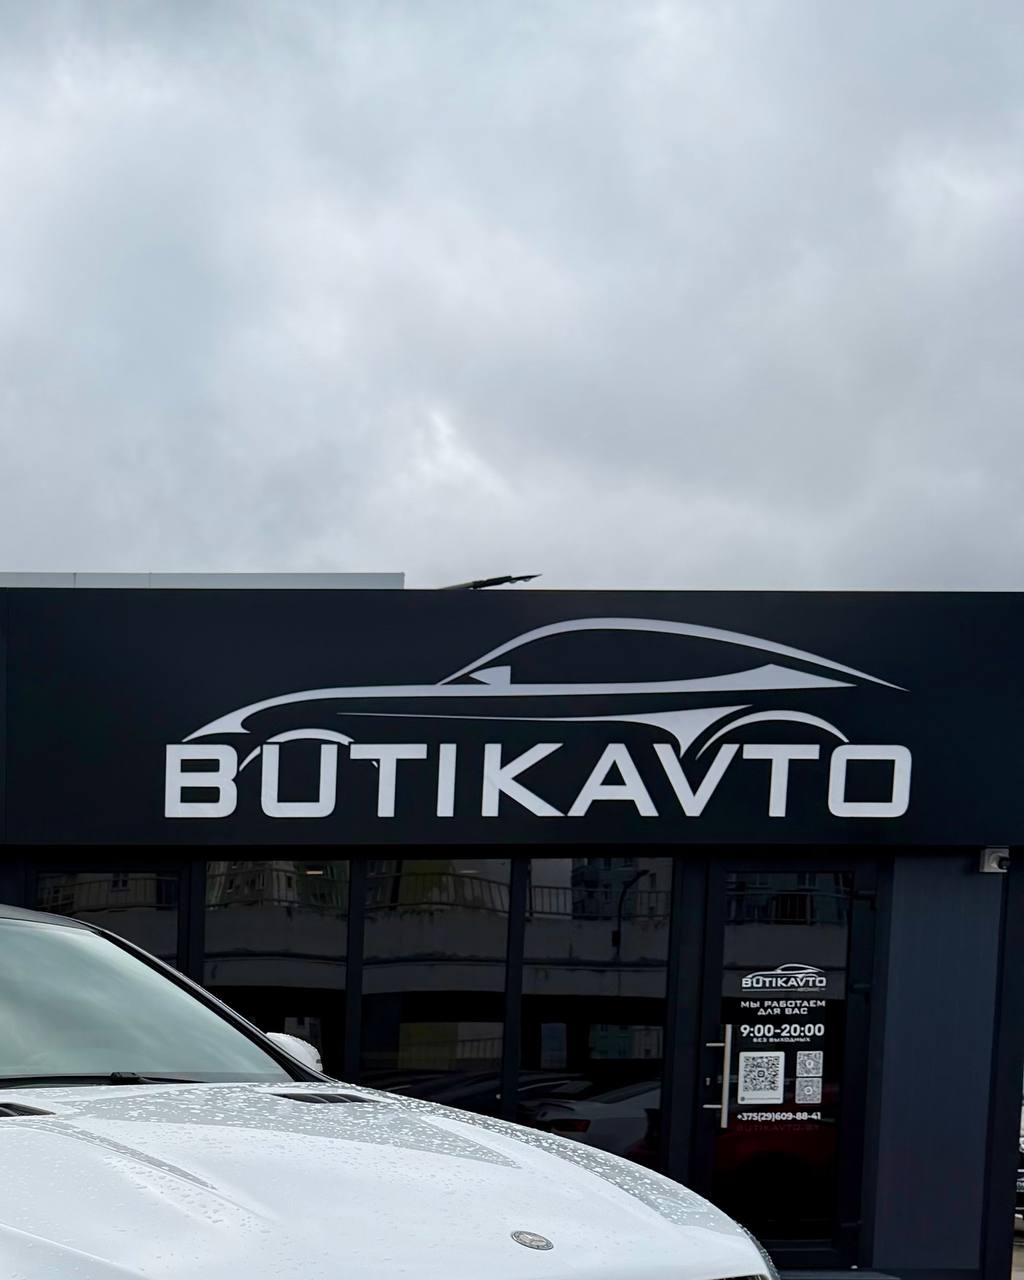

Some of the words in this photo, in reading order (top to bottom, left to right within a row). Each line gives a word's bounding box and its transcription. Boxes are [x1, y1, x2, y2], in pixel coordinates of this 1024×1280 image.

[164, 742, 912, 818] BUTIKAVTO
[741, 976, 827, 988] BUTIKAVTO
[740, 1000, 761, 1009] МЫ
[764, 999, 826, 1008] РАБОТАЕМ
[757, 1007, 781, 1016] ДЛЯ
[784, 1007, 809, 1015] ВАС
[740, 1024, 824, 1037] 9:00-20:00
[737, 1111, 821, 1122] +375(29)609-88-41
